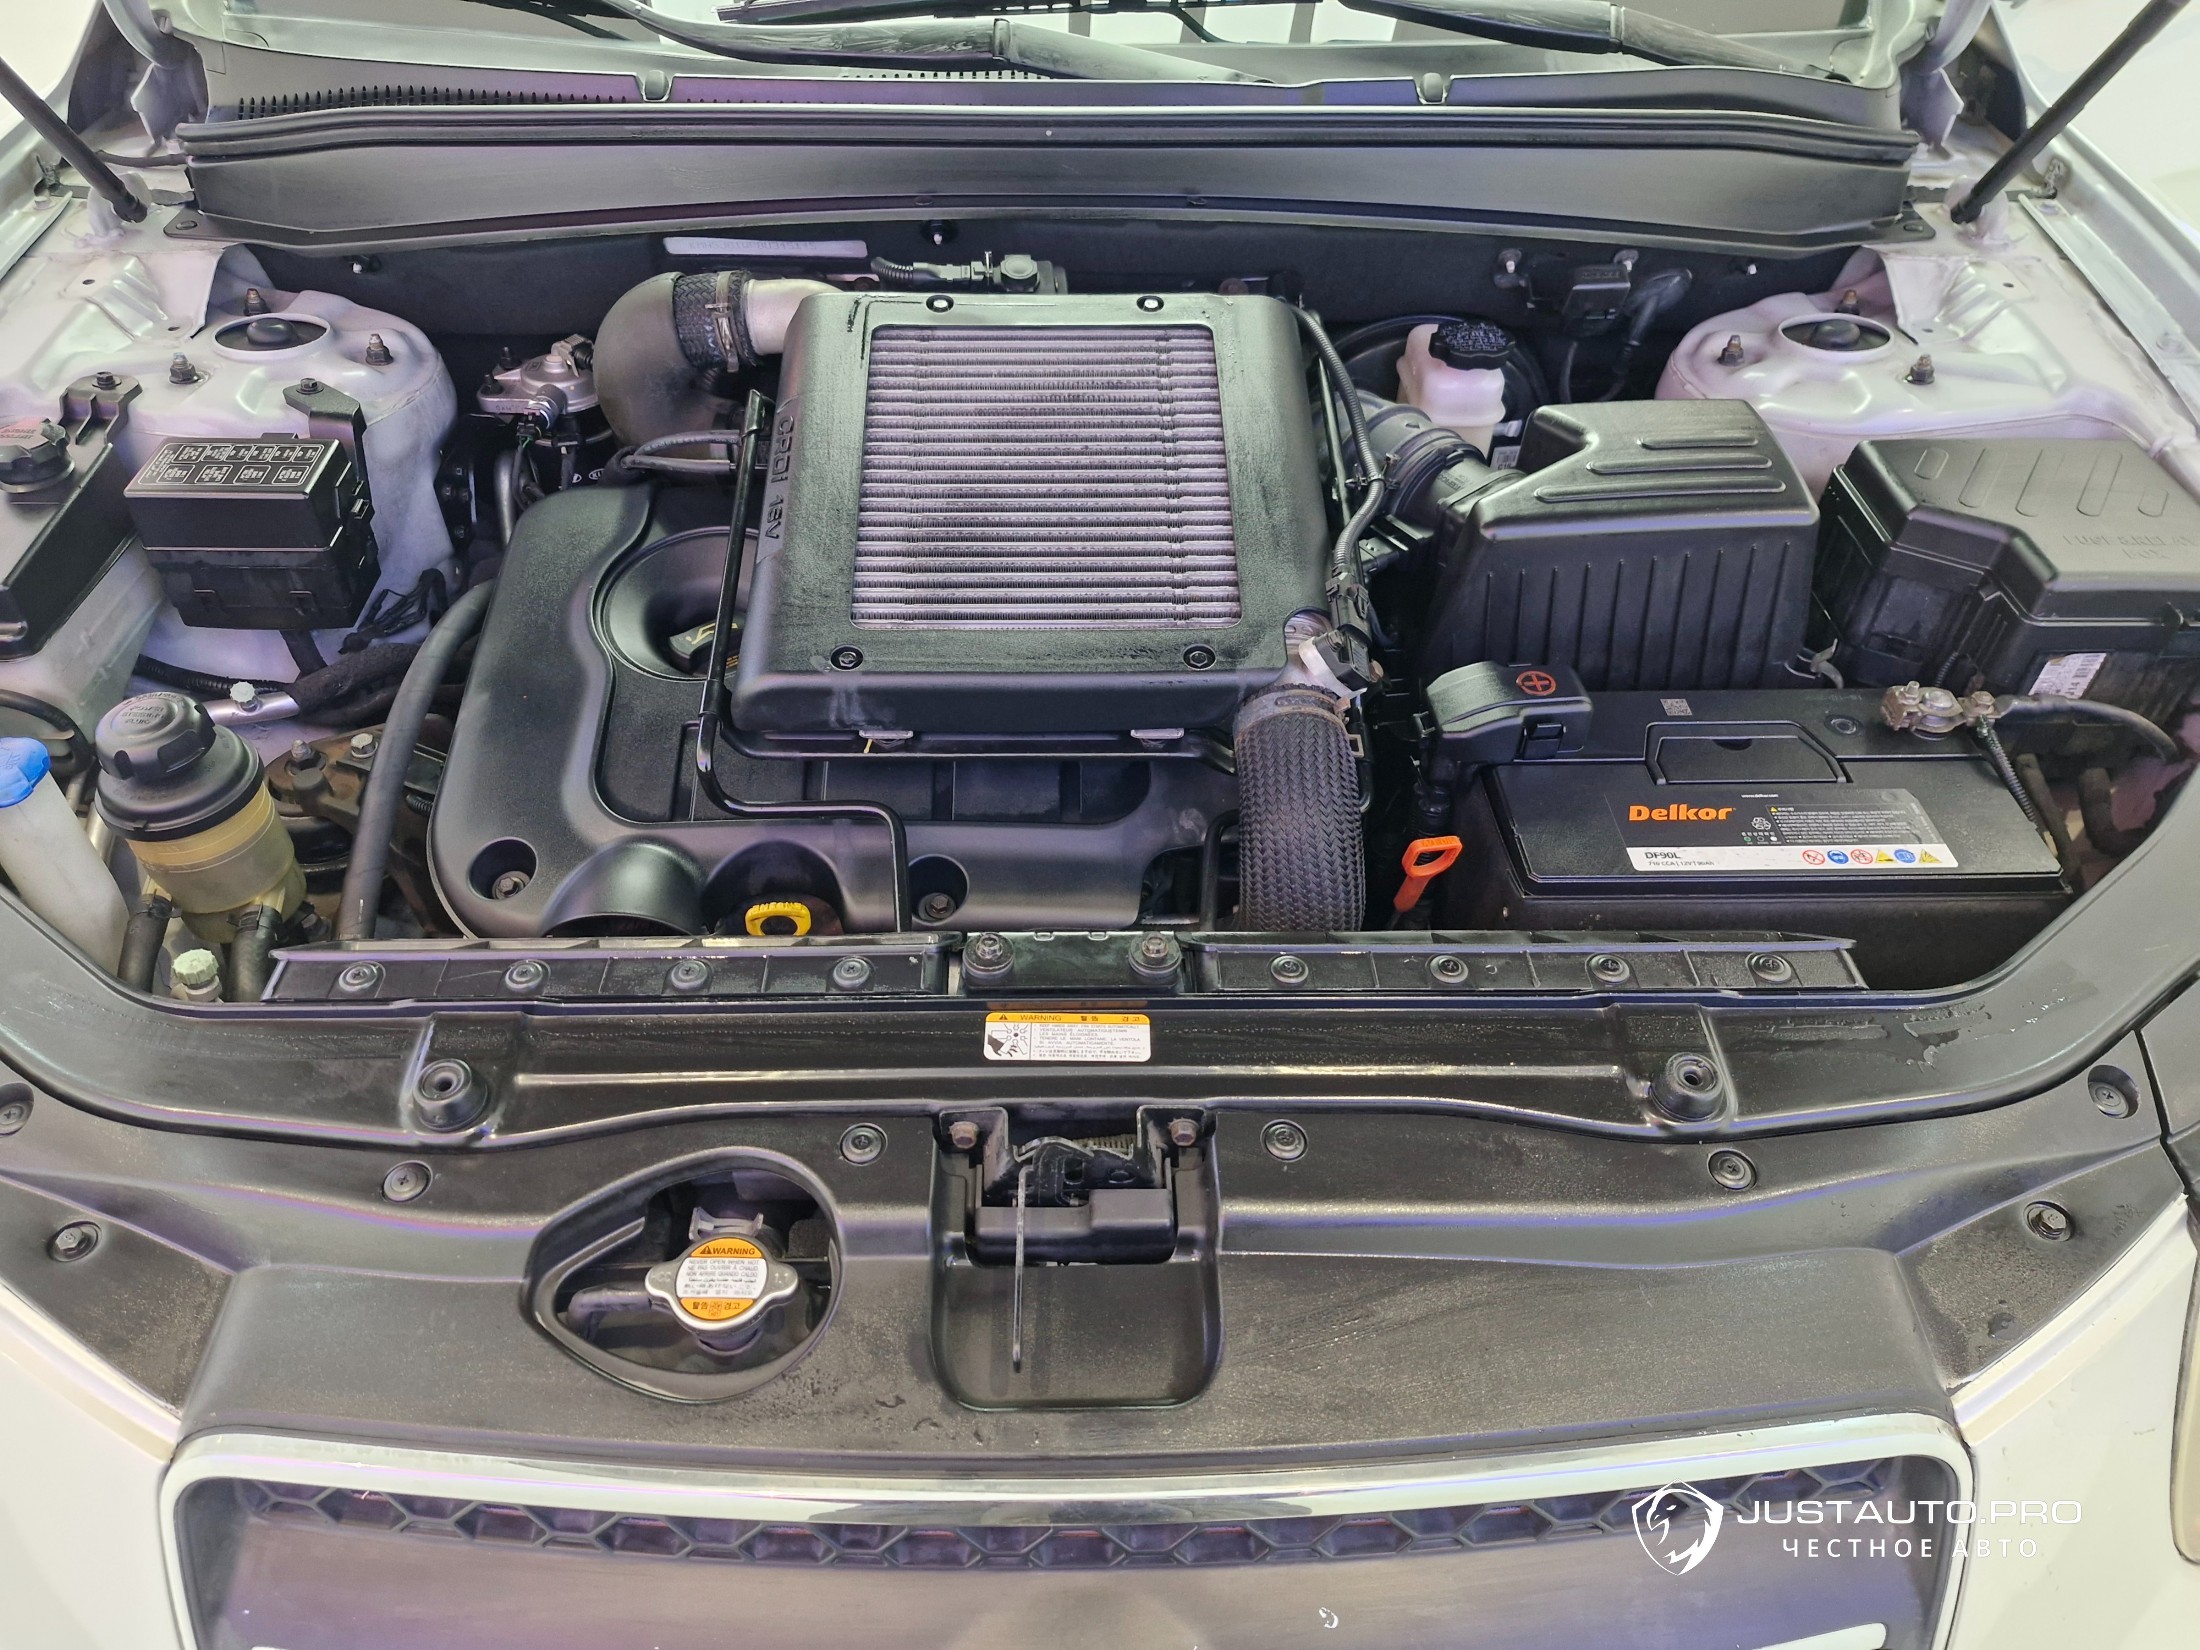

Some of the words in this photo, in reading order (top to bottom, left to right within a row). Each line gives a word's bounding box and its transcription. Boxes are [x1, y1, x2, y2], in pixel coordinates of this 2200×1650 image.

[1628, 803, 1733, 822] Delkor
[1645, 851, 1681, 859] DF90L
[712, 1247, 756, 1255] WARNING
